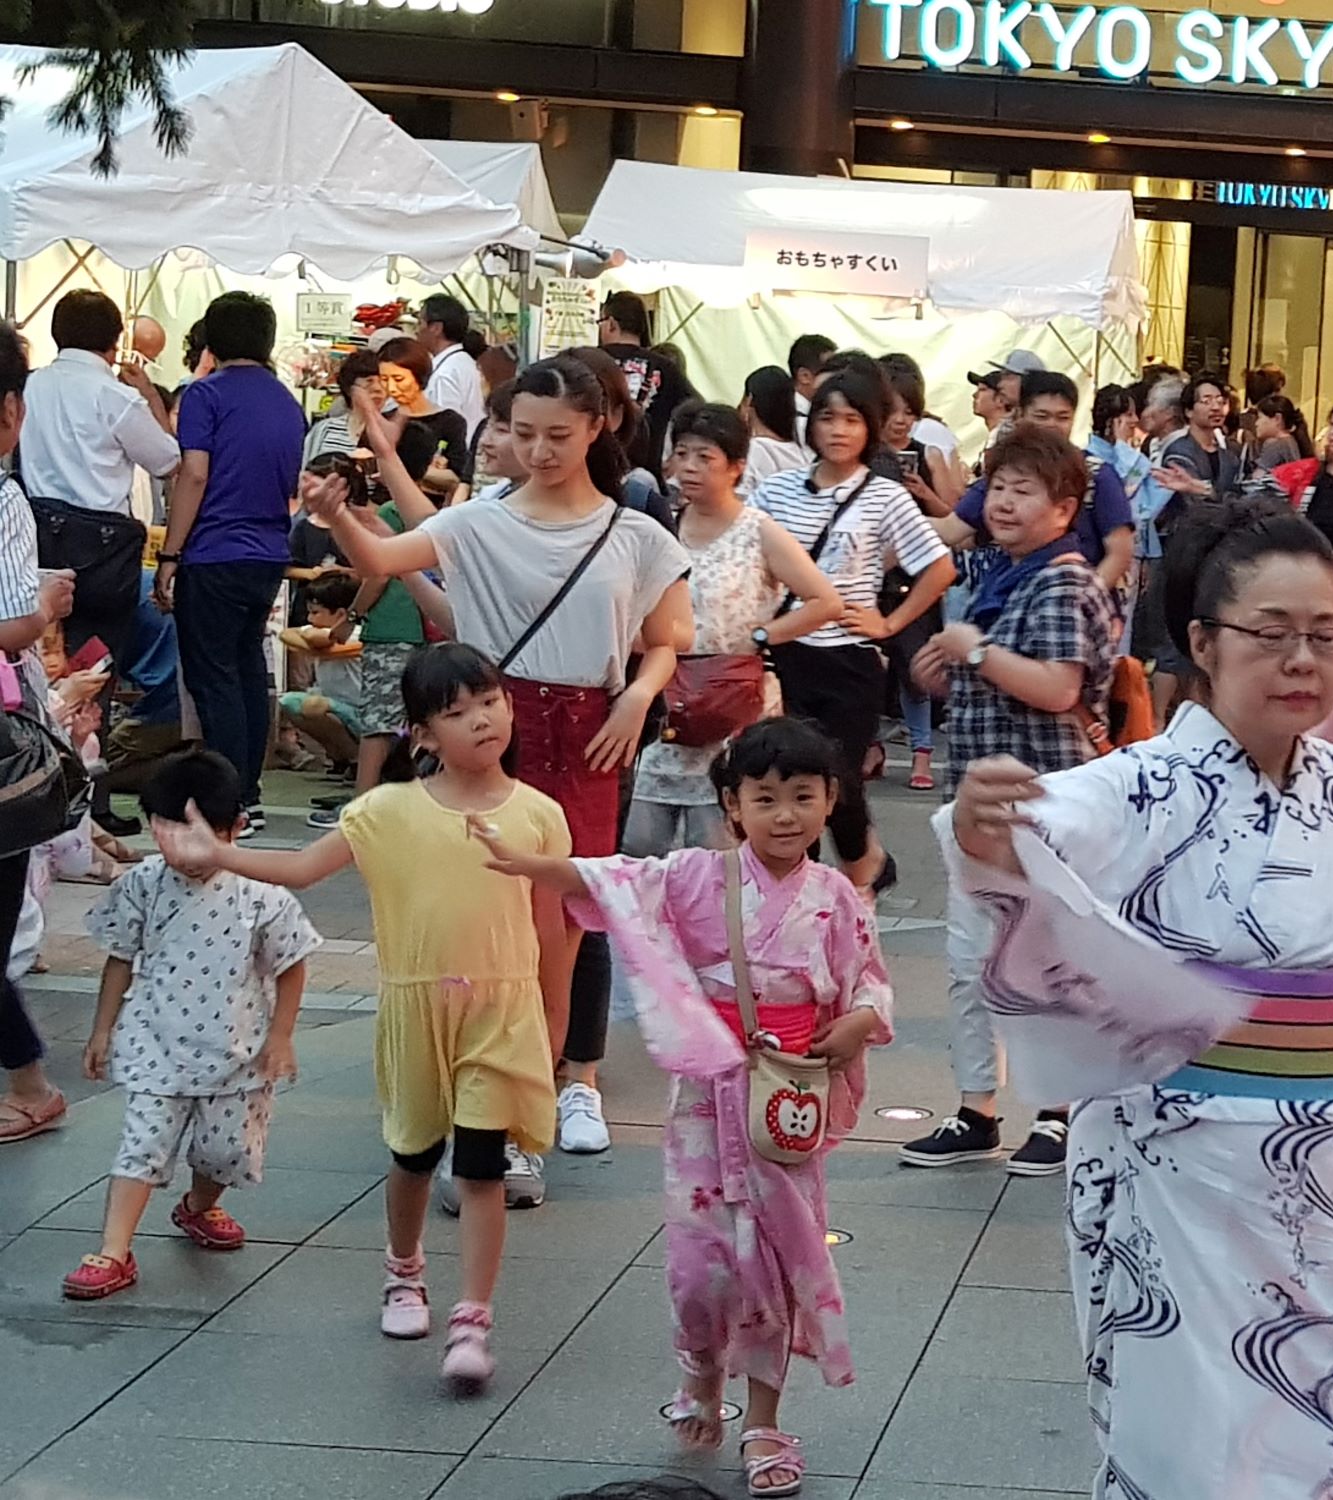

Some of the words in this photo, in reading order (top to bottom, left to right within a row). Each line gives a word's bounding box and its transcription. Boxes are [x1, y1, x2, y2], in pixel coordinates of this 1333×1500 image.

[869, 0, 1150, 80] TOKYO
[776, 249, 898, 271] おもちゃすくい
